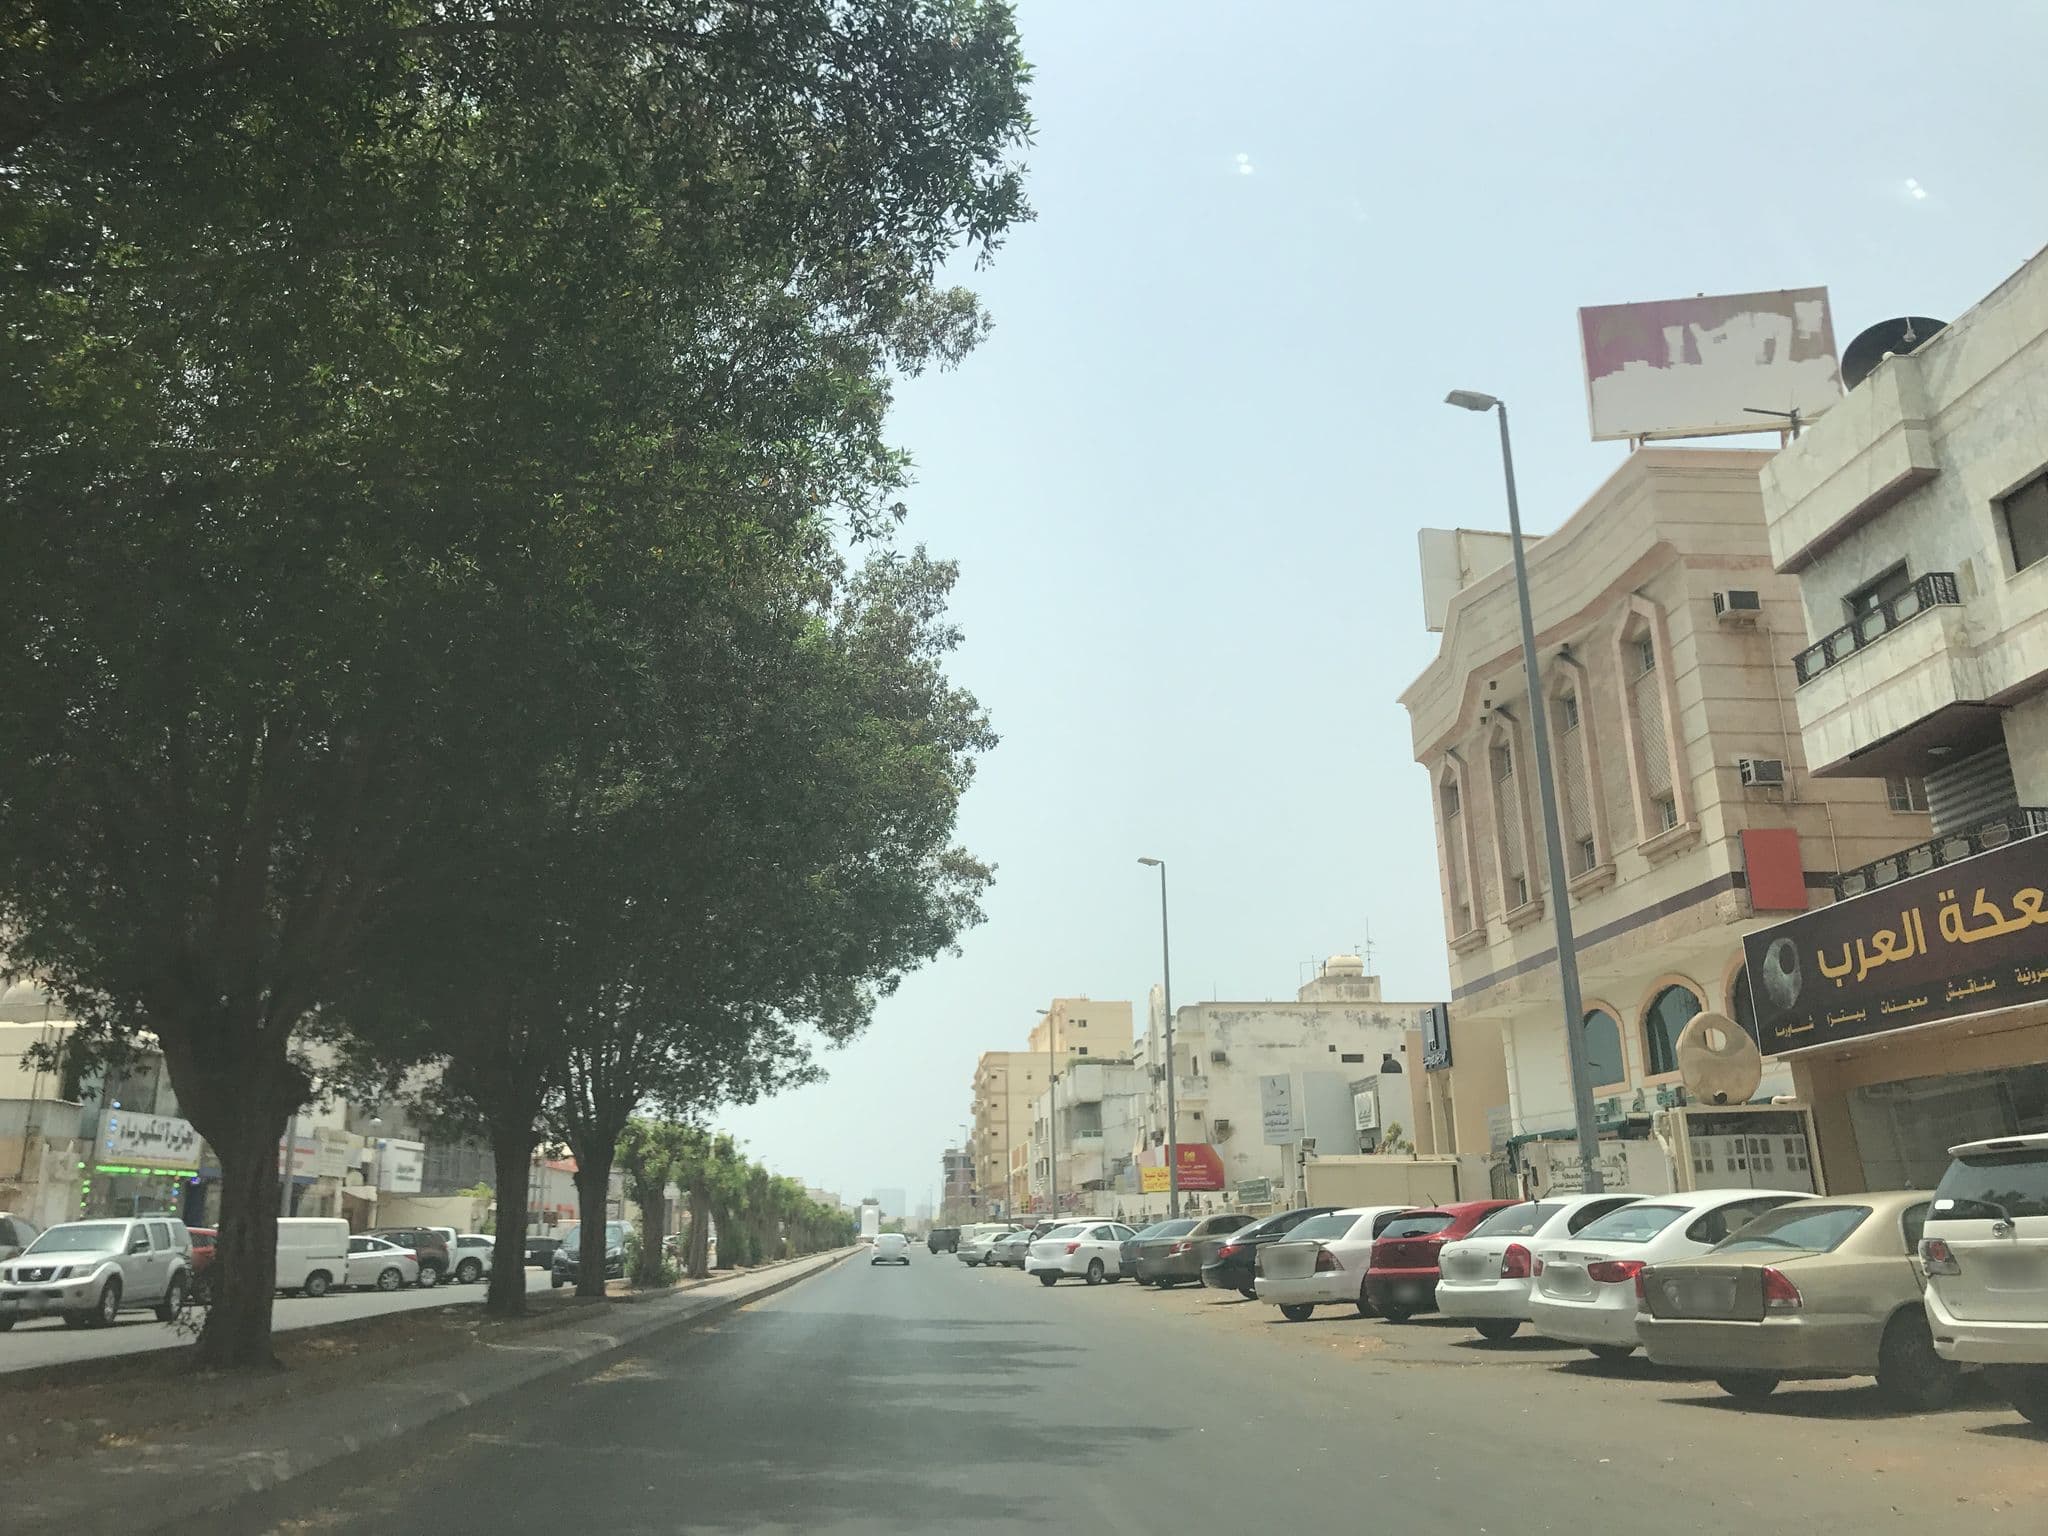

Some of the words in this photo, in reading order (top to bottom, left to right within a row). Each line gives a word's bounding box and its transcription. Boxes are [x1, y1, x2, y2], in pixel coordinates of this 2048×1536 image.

[1939, 886, 2048, 944] عكة
[1817, 907, 1927, 987] العرب
[1945, 976, 1996, 1001] مناقيش
[1880, 995, 1928, 1014] معجنات
[1775, 1015, 1814, 1037] شاورما
[1827, 1008, 1866, 1027] بيتزا
